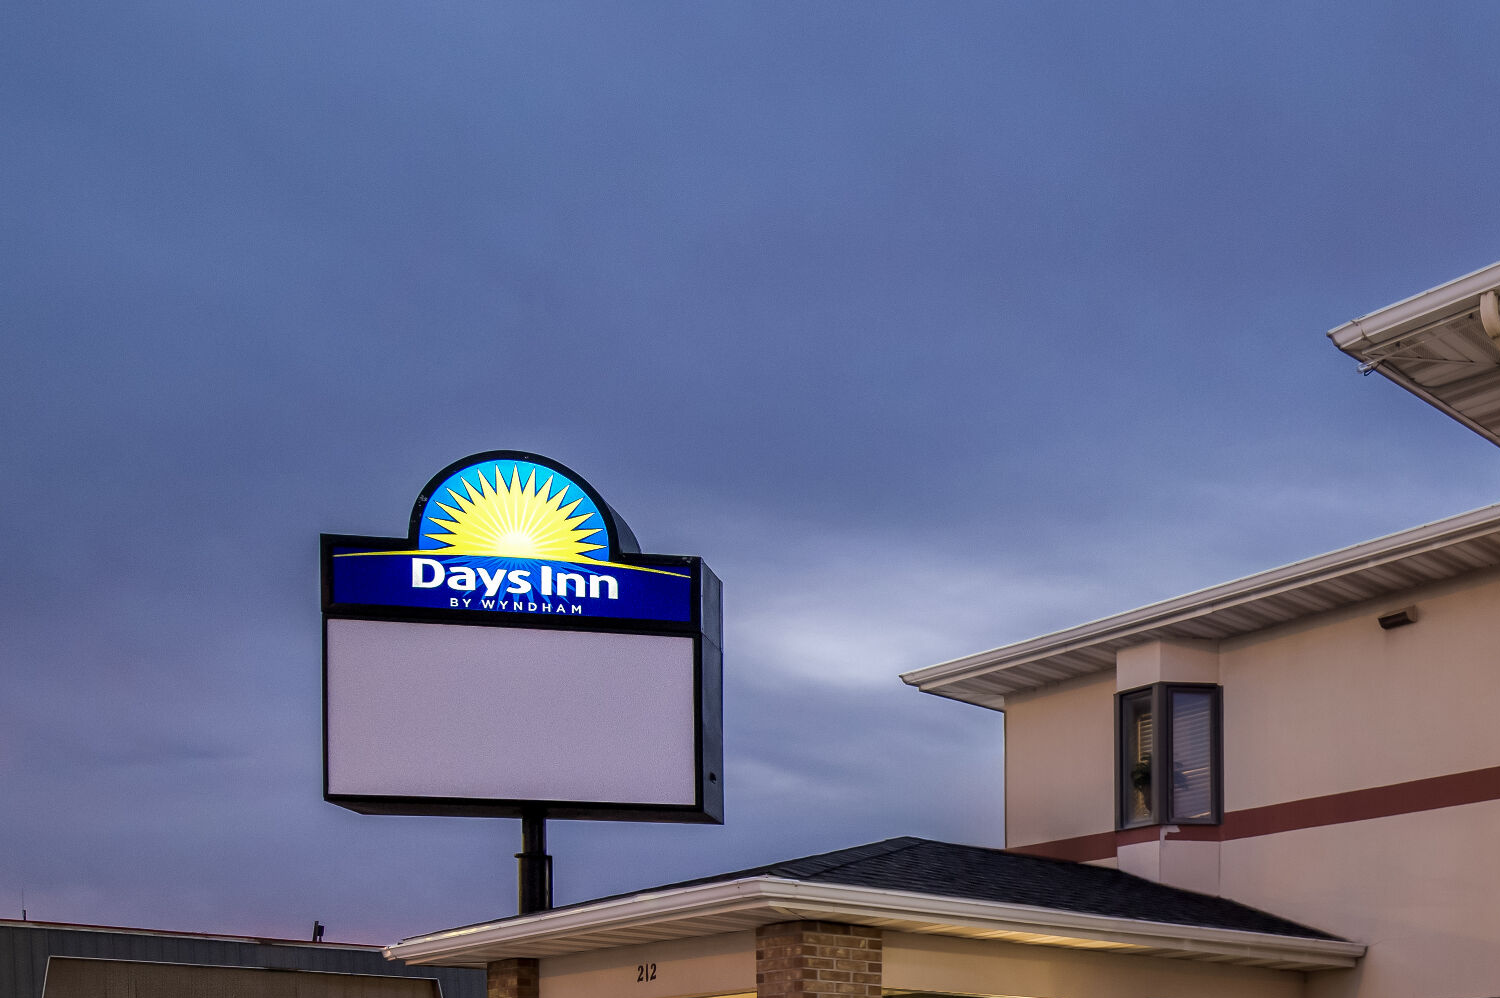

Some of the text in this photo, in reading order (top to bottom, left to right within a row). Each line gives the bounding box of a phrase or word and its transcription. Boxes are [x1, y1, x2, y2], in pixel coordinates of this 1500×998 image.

[412, 558, 619, 600] Days Inn
[450, 597, 582, 615] BY WYNDHAM
[637, 963, 657, 982] 212
